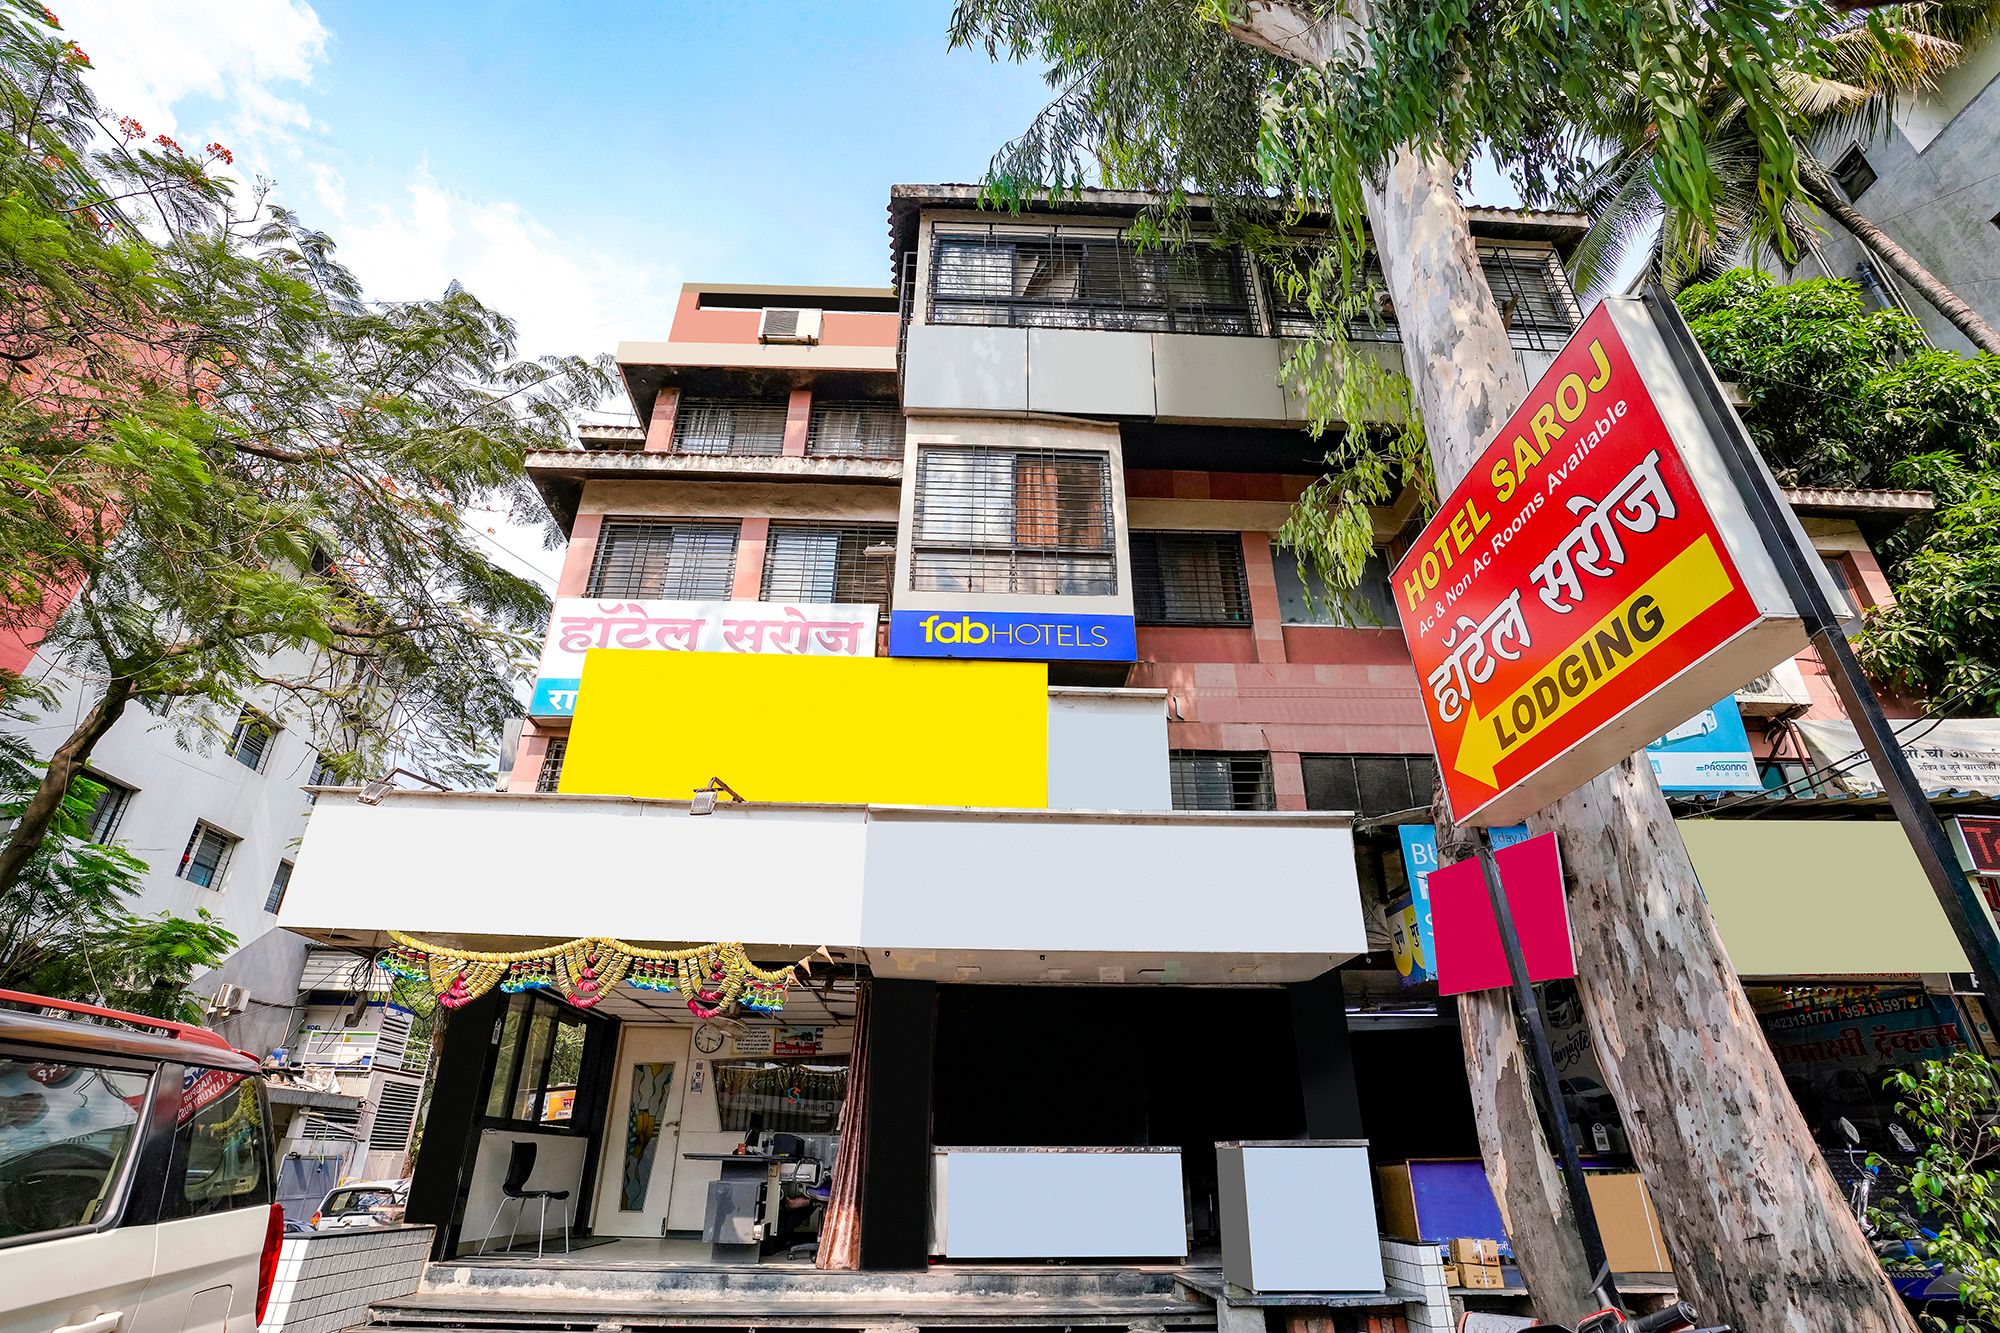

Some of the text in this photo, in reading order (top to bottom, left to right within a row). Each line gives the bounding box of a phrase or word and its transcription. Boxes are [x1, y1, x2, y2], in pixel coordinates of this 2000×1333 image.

[1403, 338, 1612, 612] HOTEL SAROJ
[1419, 399, 1628, 638] Ac & Non Ac Rooms Available
[1427, 448, 1677, 723] हॉटेल सरोज
[558, 603, 866, 655] हॉटेल सरोज
[1492, 594, 1665, 751] LODGING
